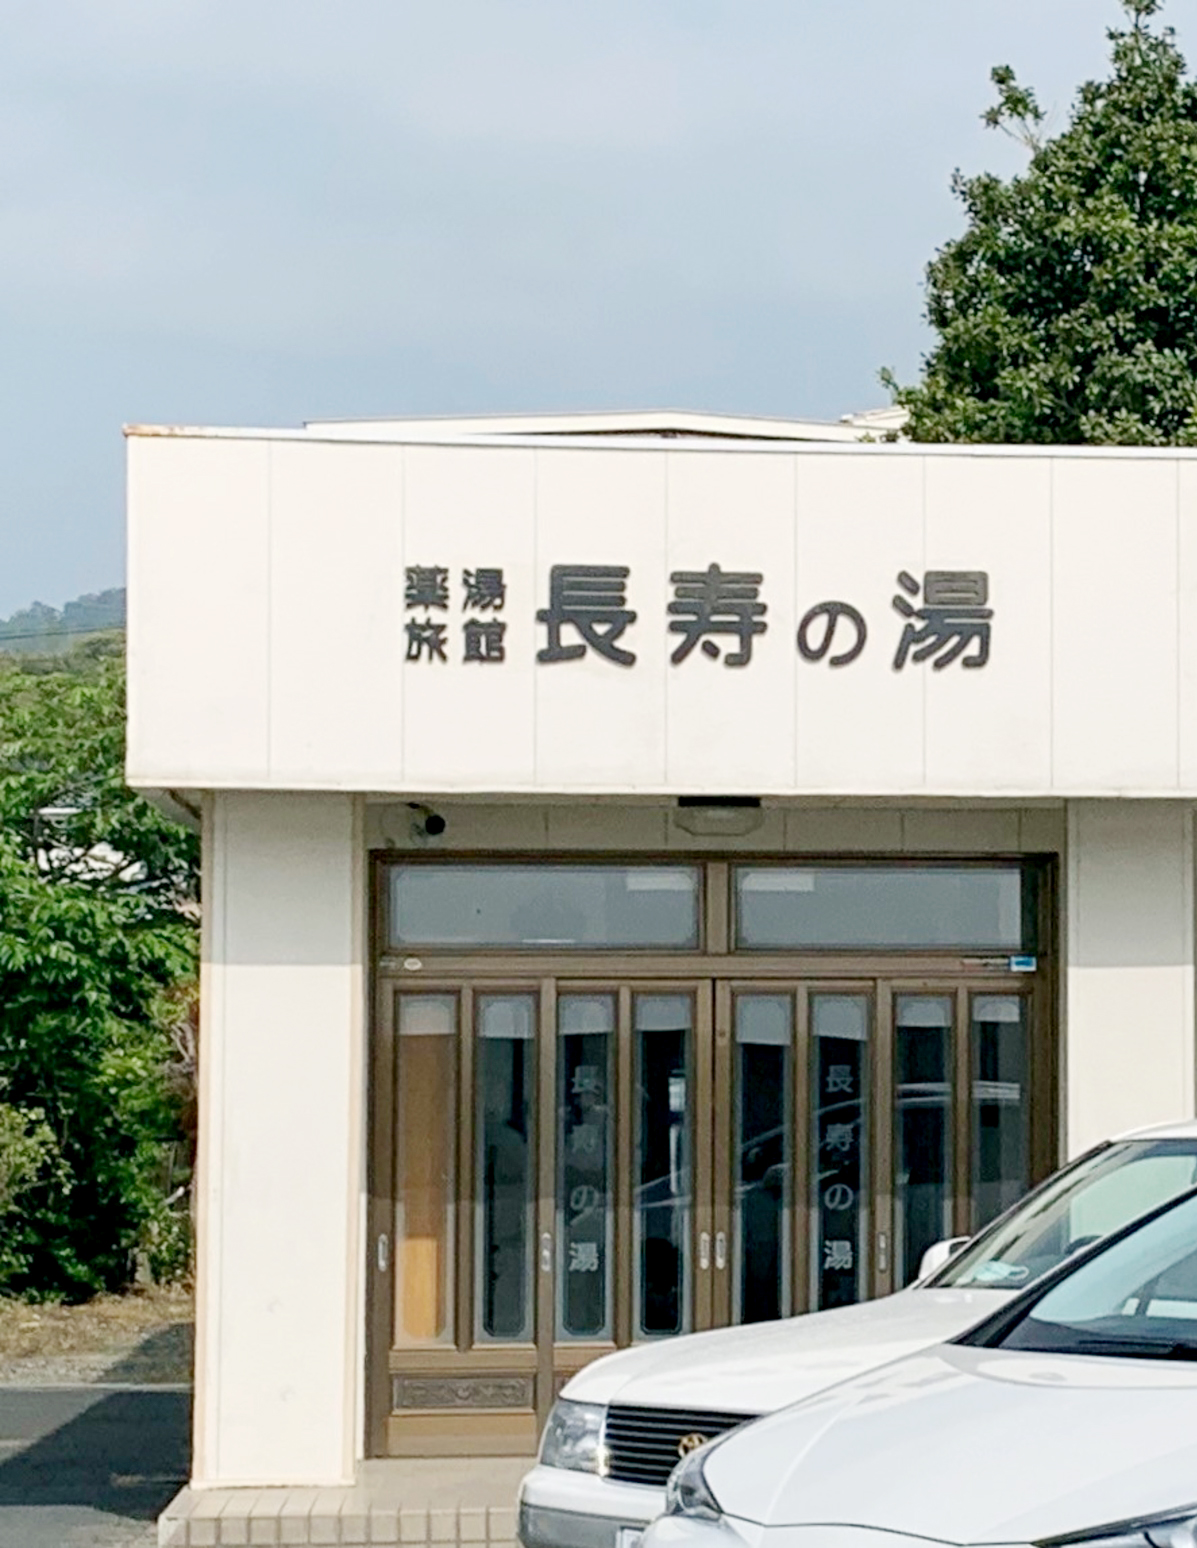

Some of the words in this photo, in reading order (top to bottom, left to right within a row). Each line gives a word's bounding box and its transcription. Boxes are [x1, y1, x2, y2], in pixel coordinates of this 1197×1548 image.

[404, 564, 506, 611] 薬湯
[535, 562, 993, 670] 長寿の湯
[404, 616, 506, 664] 旅館
[824, 1064, 854, 1270] 長寿の湯
